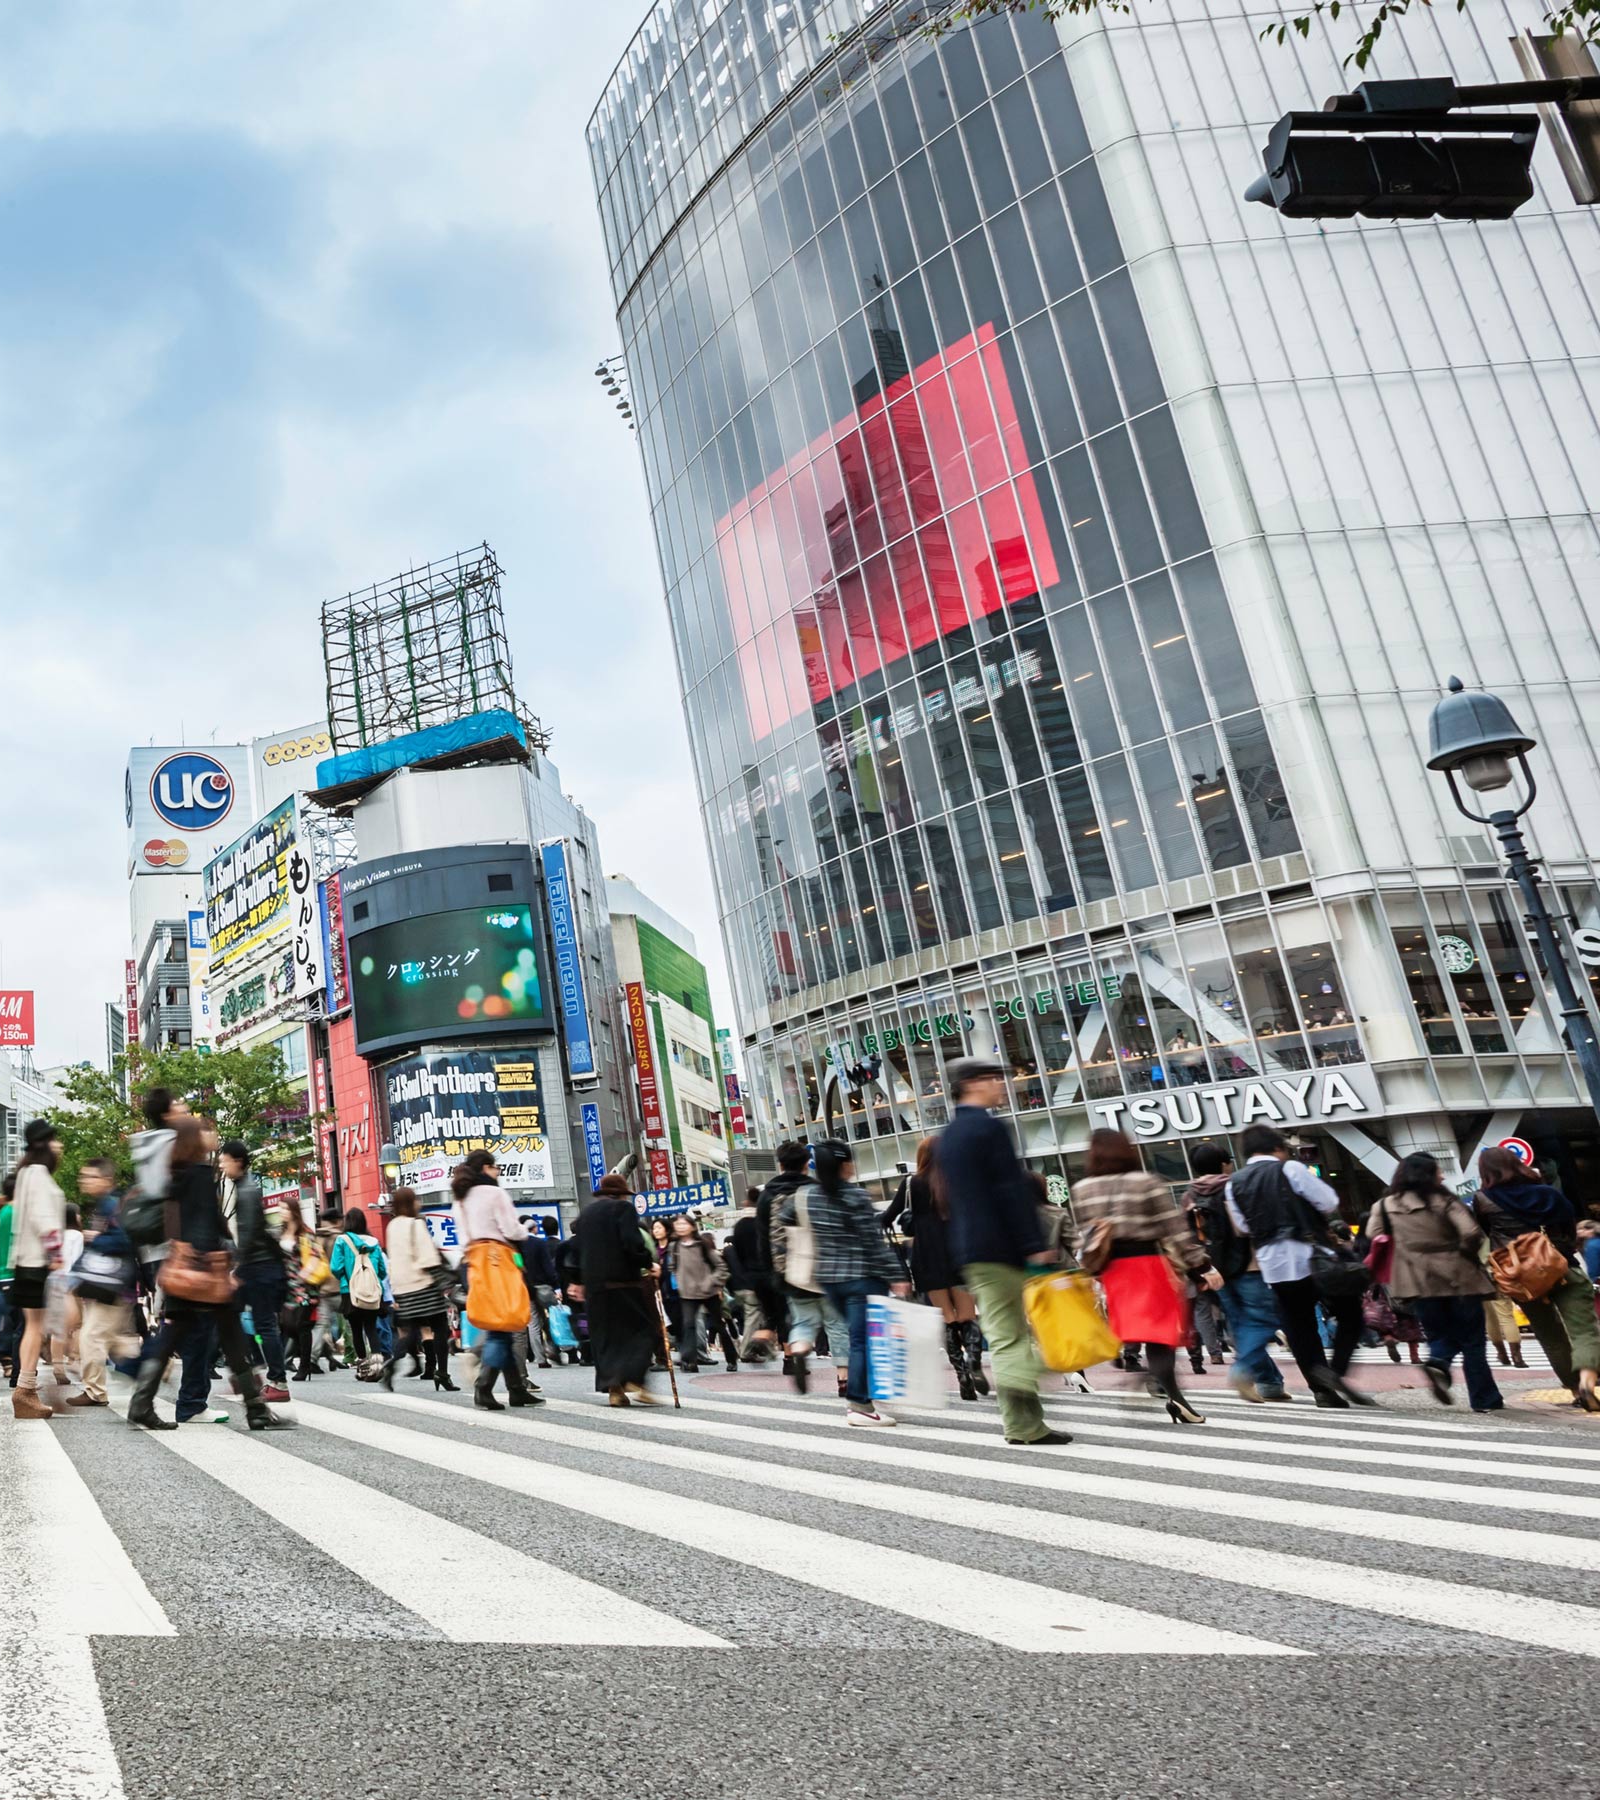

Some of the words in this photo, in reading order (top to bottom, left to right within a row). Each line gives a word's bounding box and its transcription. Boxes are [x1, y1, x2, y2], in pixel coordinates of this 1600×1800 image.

[144, 847, 188, 857] MasterCard
[343, 877, 367, 893] Mighty
[366, 869, 390, 885] Vision
[393, 862, 423, 874] SHIBUYA
[289, 850, 317, 986] もんじゃ
[547, 867, 574, 946] Taisei
[387, 947, 480, 980] クロッシング
[406, 966, 459, 983] crossing
[560, 950, 580, 1017] neon
[994, 974, 1123, 1025] COFFEE
[3, 1030, 30, 1040] 150m
[629, 986, 650, 1071] クスリのことなら
[640, 1076, 662, 1131] 三千里
[420, 1066, 496, 1097] Brothers
[526, 1072, 533, 1083] 2
[1094, 1072, 1367, 1137] TSUTAYA
[424, 1109, 501, 1140] Brothers
[530, 1115, 538, 1127] 2
[341, 1101, 370, 1190] クスリ
[647, 1182, 724, 1208] 歩きタバコ禁止
